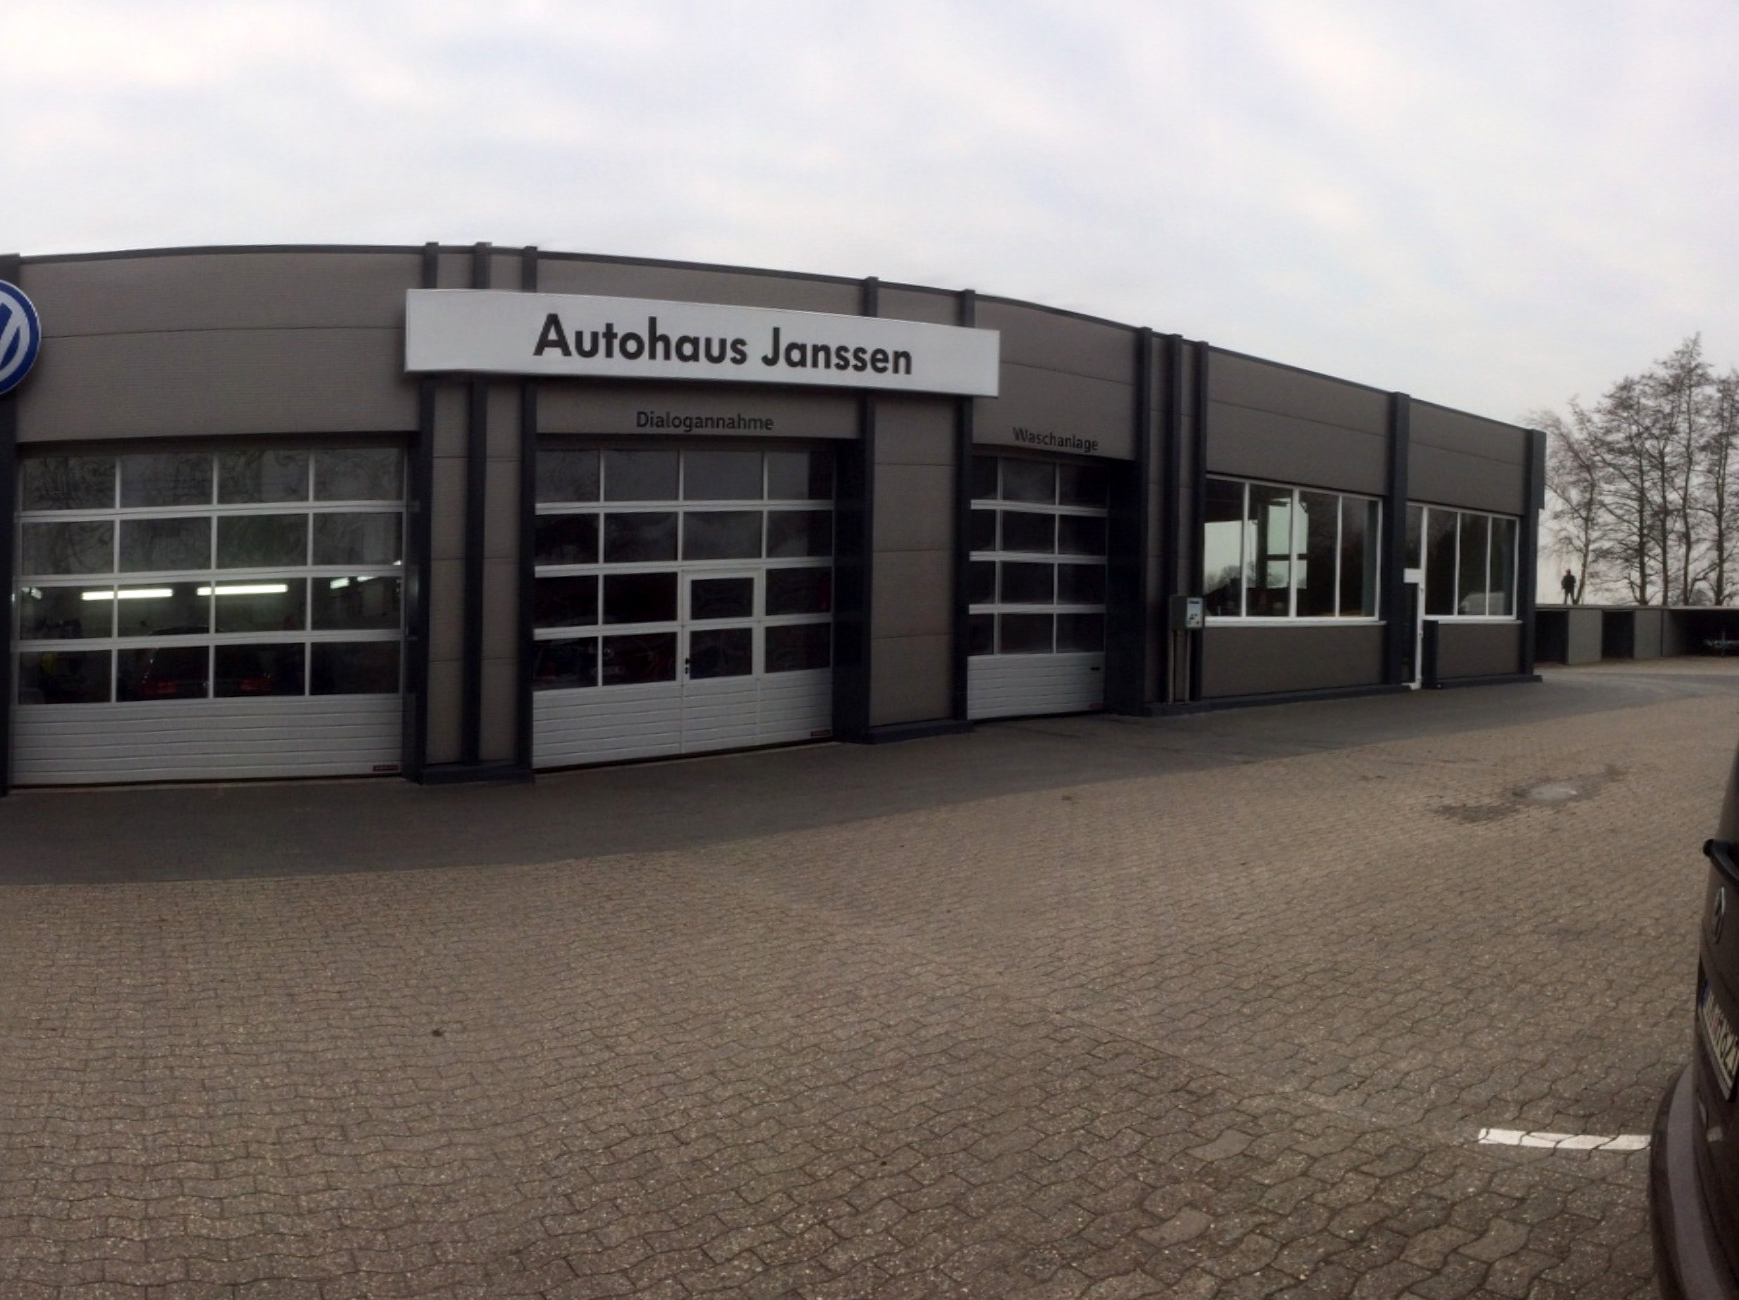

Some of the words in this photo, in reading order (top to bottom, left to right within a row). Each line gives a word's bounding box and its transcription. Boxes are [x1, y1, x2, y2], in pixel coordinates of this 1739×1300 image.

[533, 313, 748, 366] Autohaus
[761, 326, 913, 375] Janssen
[635, 410, 775, 432] Dialogannahme
[1012, 426, 1099, 454] Waschanlage
